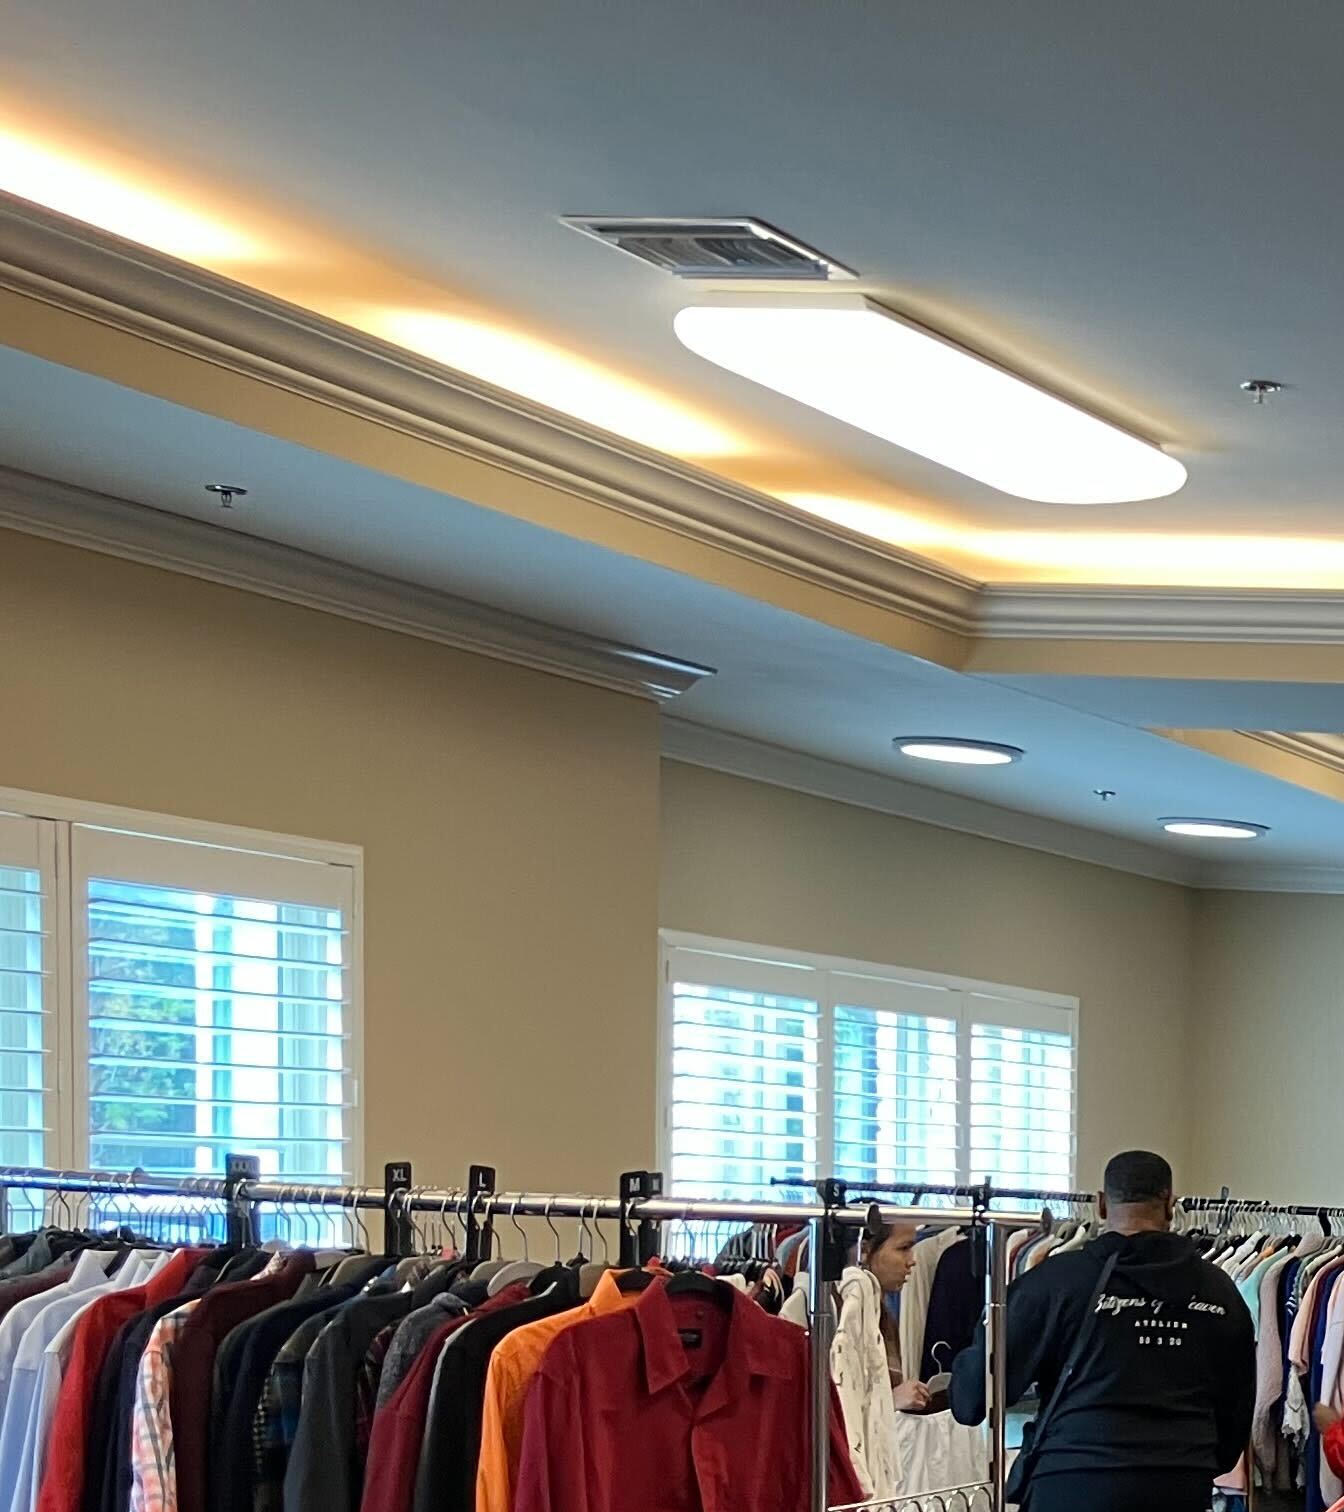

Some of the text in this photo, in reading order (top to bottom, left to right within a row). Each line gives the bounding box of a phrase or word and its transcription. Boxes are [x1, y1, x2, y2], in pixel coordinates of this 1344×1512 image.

[392, 1168, 408, 1182] XL
[478, 1171, 487, 1187] L
[629, 1177, 641, 1193] M
[832, 1184, 840, 1198] S
[1134, 1319, 1188, 1329] ATELIER
